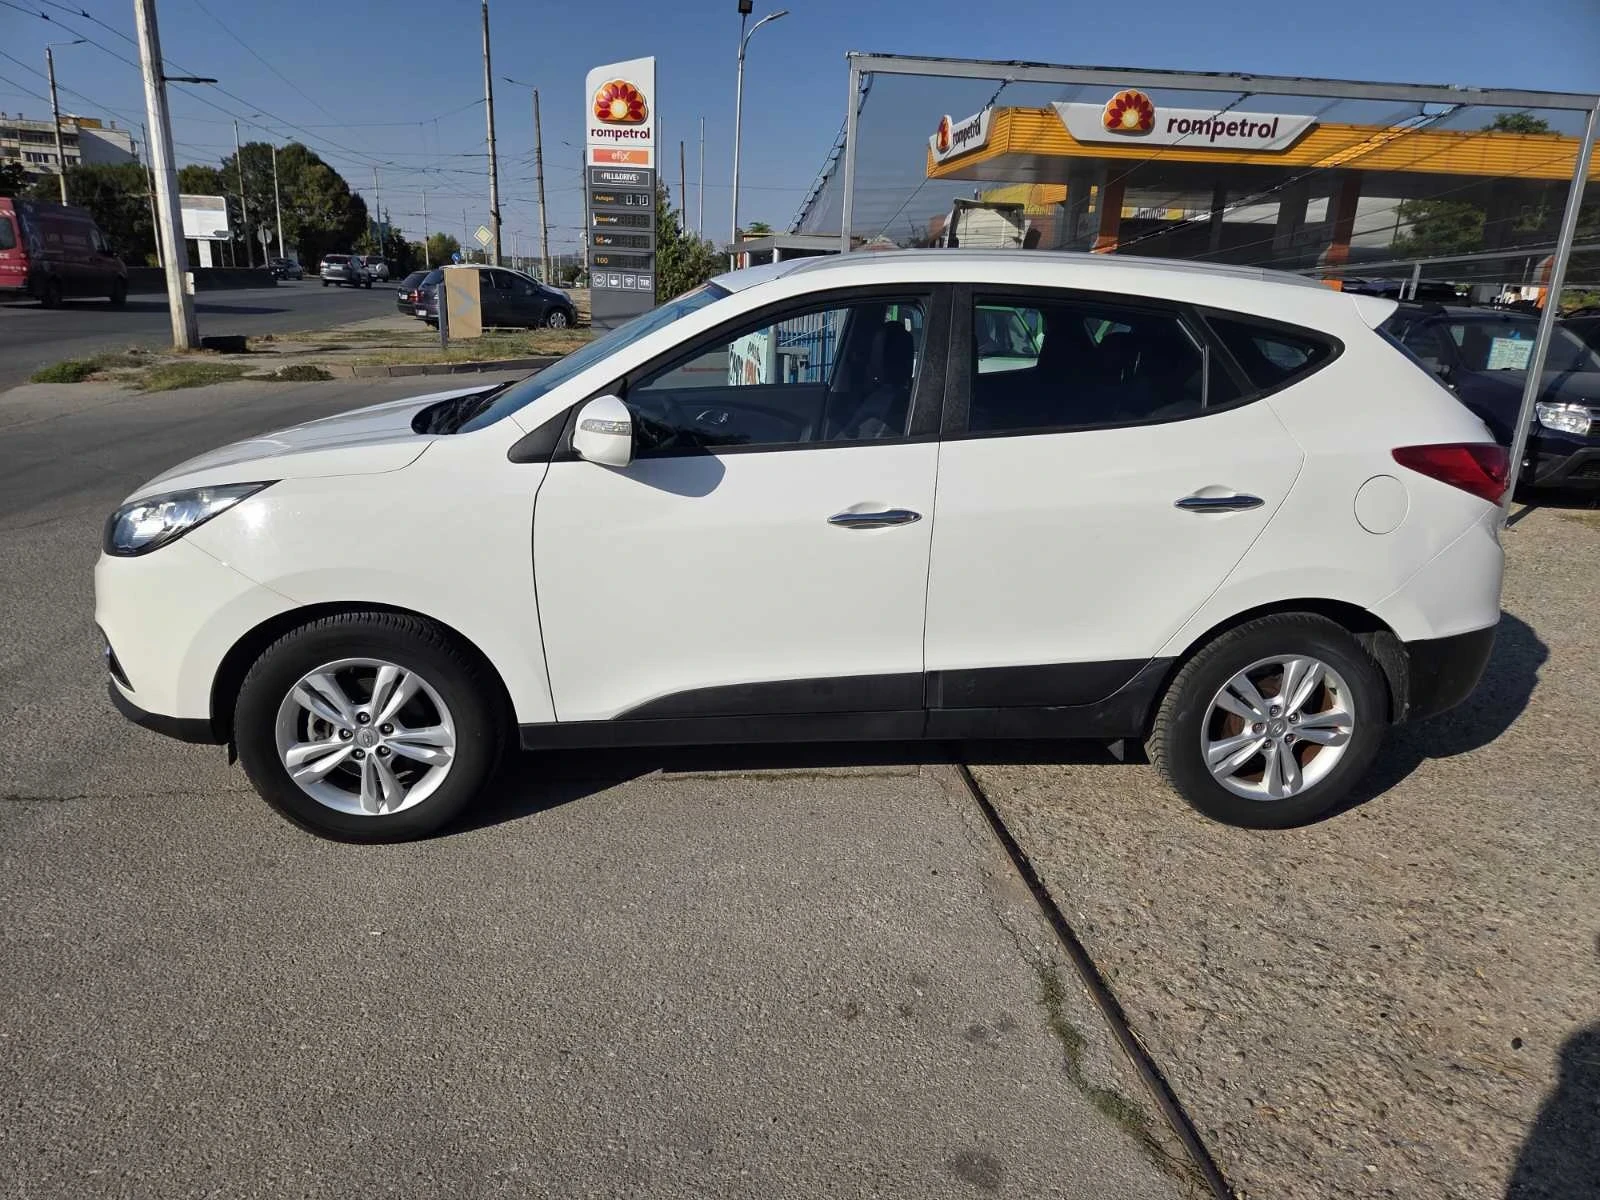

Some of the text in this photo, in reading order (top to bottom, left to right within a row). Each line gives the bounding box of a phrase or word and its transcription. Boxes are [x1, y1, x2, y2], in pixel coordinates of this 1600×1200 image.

[591, 127, 650, 141] rompetrol
[953, 114, 981, 148] rompetrol
[1167, 117, 1279, 142] rompetrol
